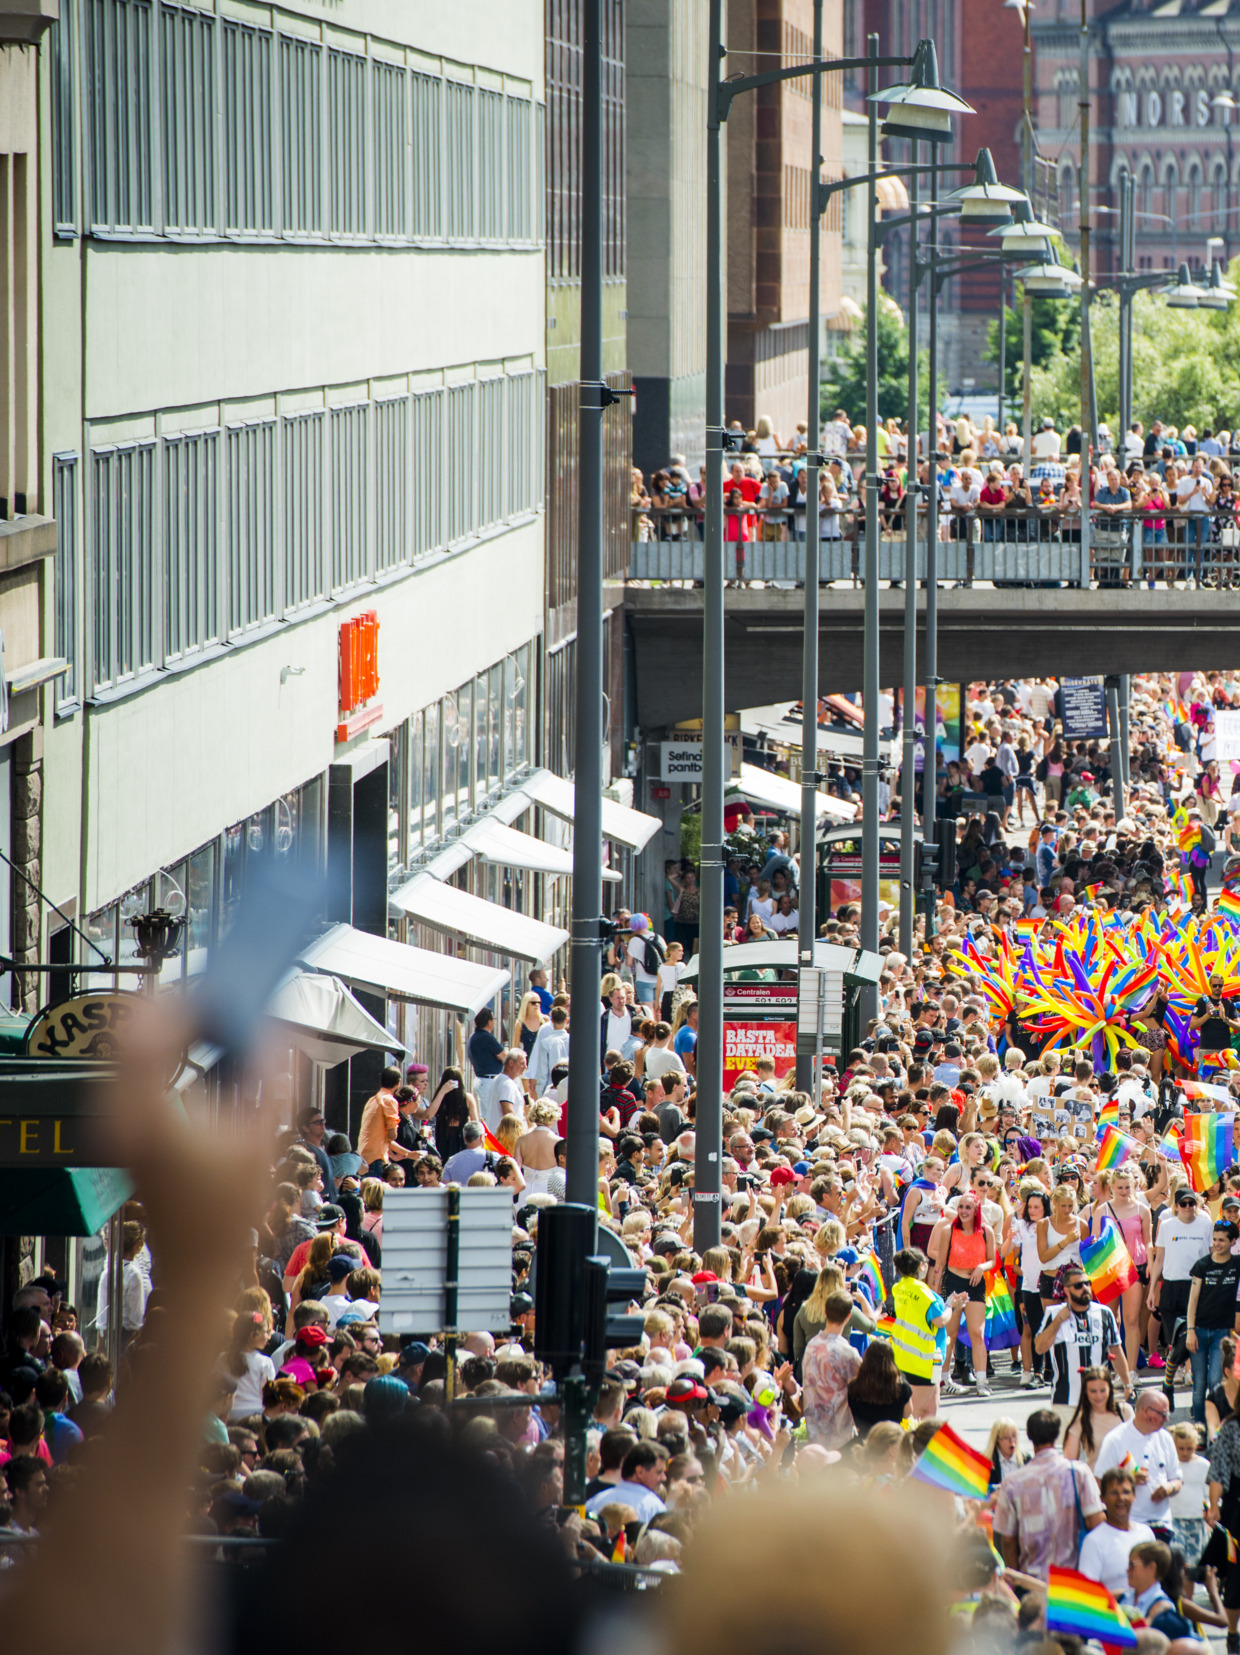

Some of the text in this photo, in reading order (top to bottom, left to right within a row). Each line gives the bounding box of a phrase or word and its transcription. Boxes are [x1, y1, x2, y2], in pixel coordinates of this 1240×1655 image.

[668, 763, 703, 773] pantb
[737, 988, 771, 996] Centralen
[726, 1029, 776, 1043] BÄSTA
[725, 1043, 796, 1057] DATADEA
[725, 1057, 759, 1070] EVE
[1073, 1332, 1099, 1345] Jeep
